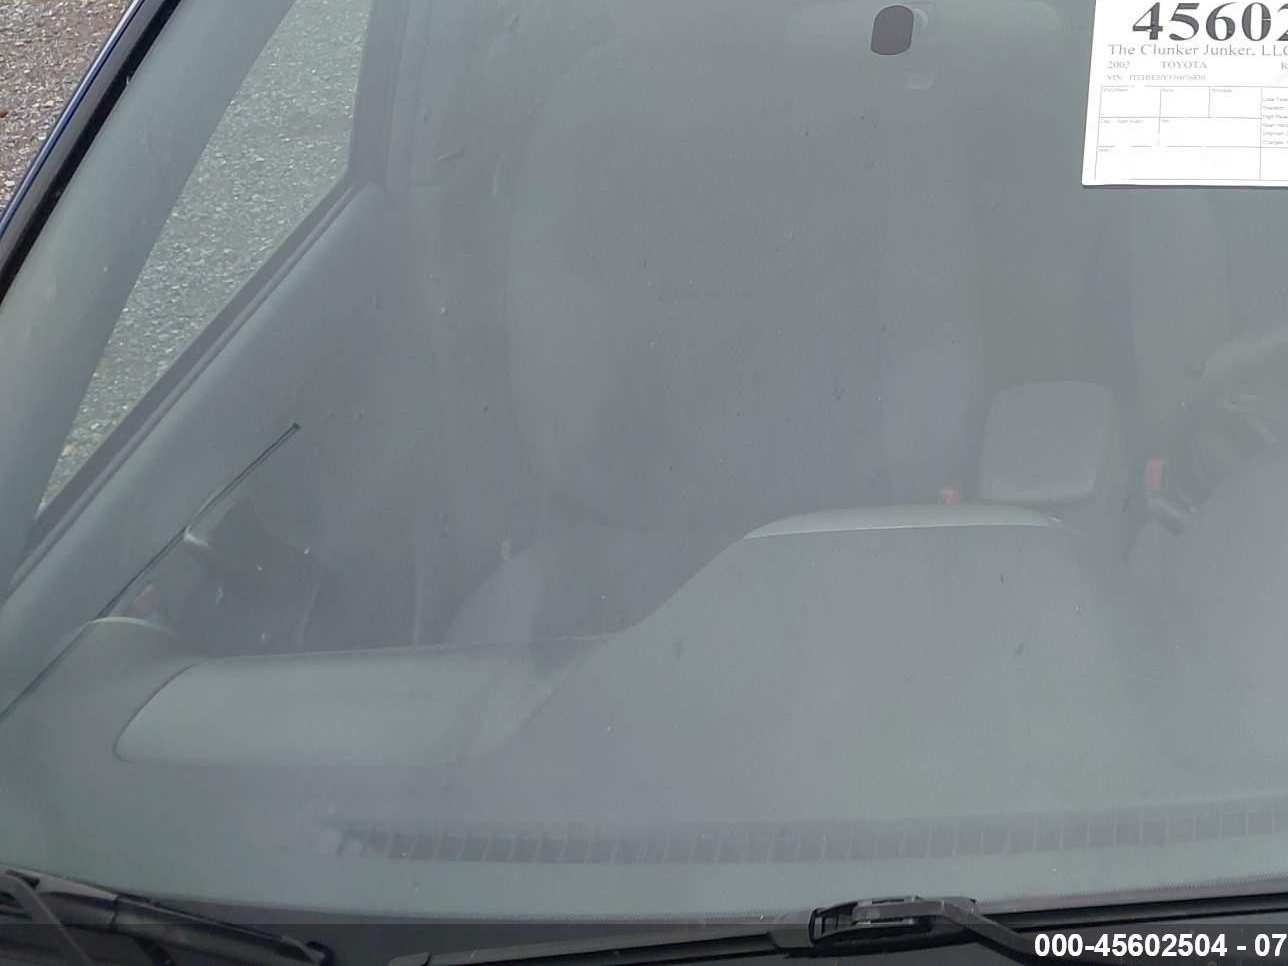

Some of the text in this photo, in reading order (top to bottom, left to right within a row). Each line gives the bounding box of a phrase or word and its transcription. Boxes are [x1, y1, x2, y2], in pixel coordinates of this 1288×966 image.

[1107, 44, 1136, 56] The
[1140, 44, 1199, 56] Clunker
[1160, 60, 1208, 69] TOYOTA
